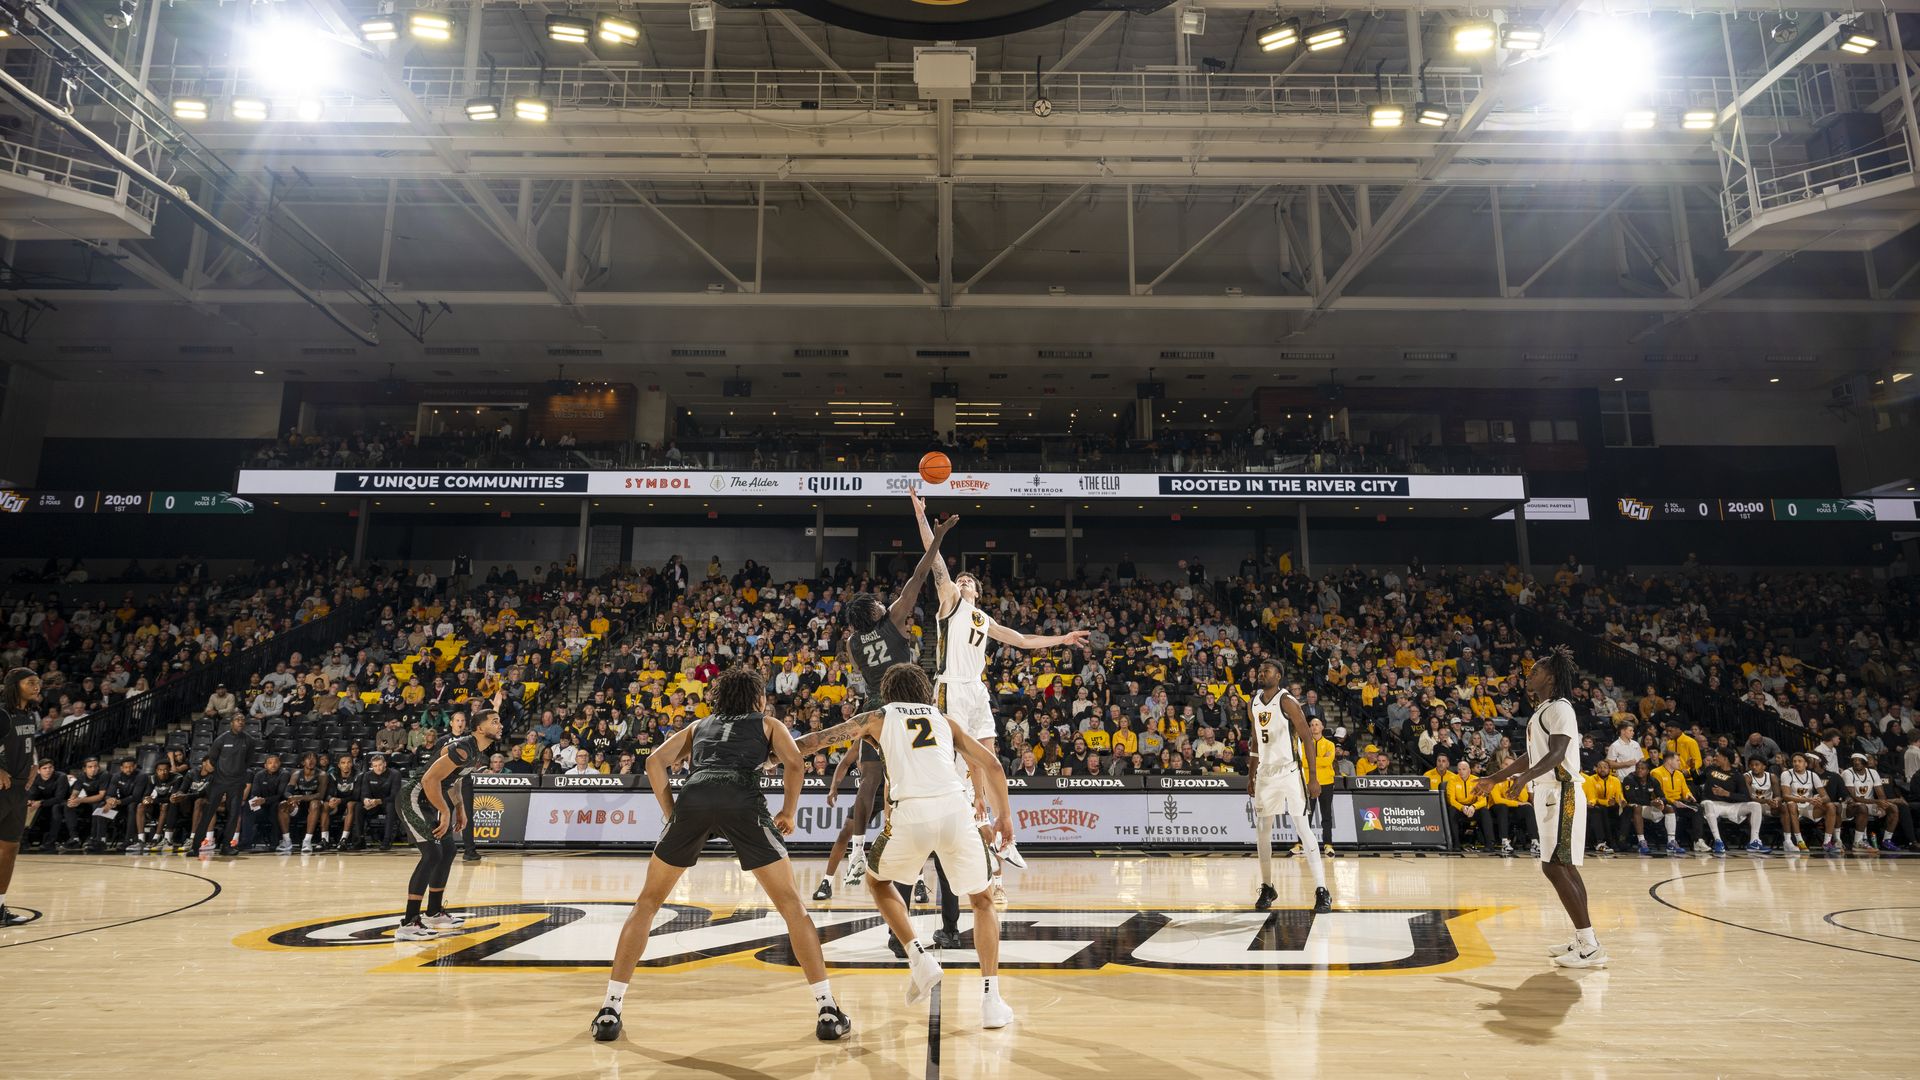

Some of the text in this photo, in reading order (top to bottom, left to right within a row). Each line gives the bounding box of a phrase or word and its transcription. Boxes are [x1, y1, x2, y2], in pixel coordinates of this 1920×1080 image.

[358, 476, 564, 489] 7 UNIQUE COMMUNITIES
[625, 478, 691, 489] SYMBOL
[730, 477, 779, 487] The Alder
[808, 477, 862, 493] GUILD
[886, 479, 924, 489] SCOUT
[950, 479, 990, 490] PRESERVE
[1084, 476, 1120, 490] THE ELLA
[1171, 480, 1398, 492] ROOTED IN THE RIVER CITY
[74, 496, 84, 508] 0
[104, 495, 141, 505] 20:00
[165, 496, 175, 509] 0
[1621, 499, 1650, 520] VCU
[1699, 503, 1708, 516] 0
[1728, 502, 1764, 513] 20:00
[1788, 503, 1797, 516] 0
[860, 630, 881, 643] BASIL
[968, 627, 985, 647] 17
[864, 641, 892, 667] 22
[896, 707, 932, 716] TRACEY
[720, 722, 735, 742] 1
[906, 717, 937, 749] 2
[1262, 729, 1268, 743] 5
[477, 777, 532, 786] HONDA
[567, 777, 623, 786] HONDA
[770, 778, 826, 786] HDA
[1070, 778, 1125, 787] HONDA
[1174, 779, 1229, 787] HONDA
[1052, 797, 1063, 806] the
[473, 810, 504, 819] ASSEY
[550, 809, 637, 824] SYMBOL
[1383, 806, 1425, 816] Children's
[797, 807, 881, 834] GUID
[1016, 808, 1100, 830] PRESERVE
[1384, 816, 1421, 826] Hospital
[473, 827, 500, 838] VCU
[1114, 825, 1228, 835] THE WESTBROOK
[268, 902, 1458, 970] VCU
